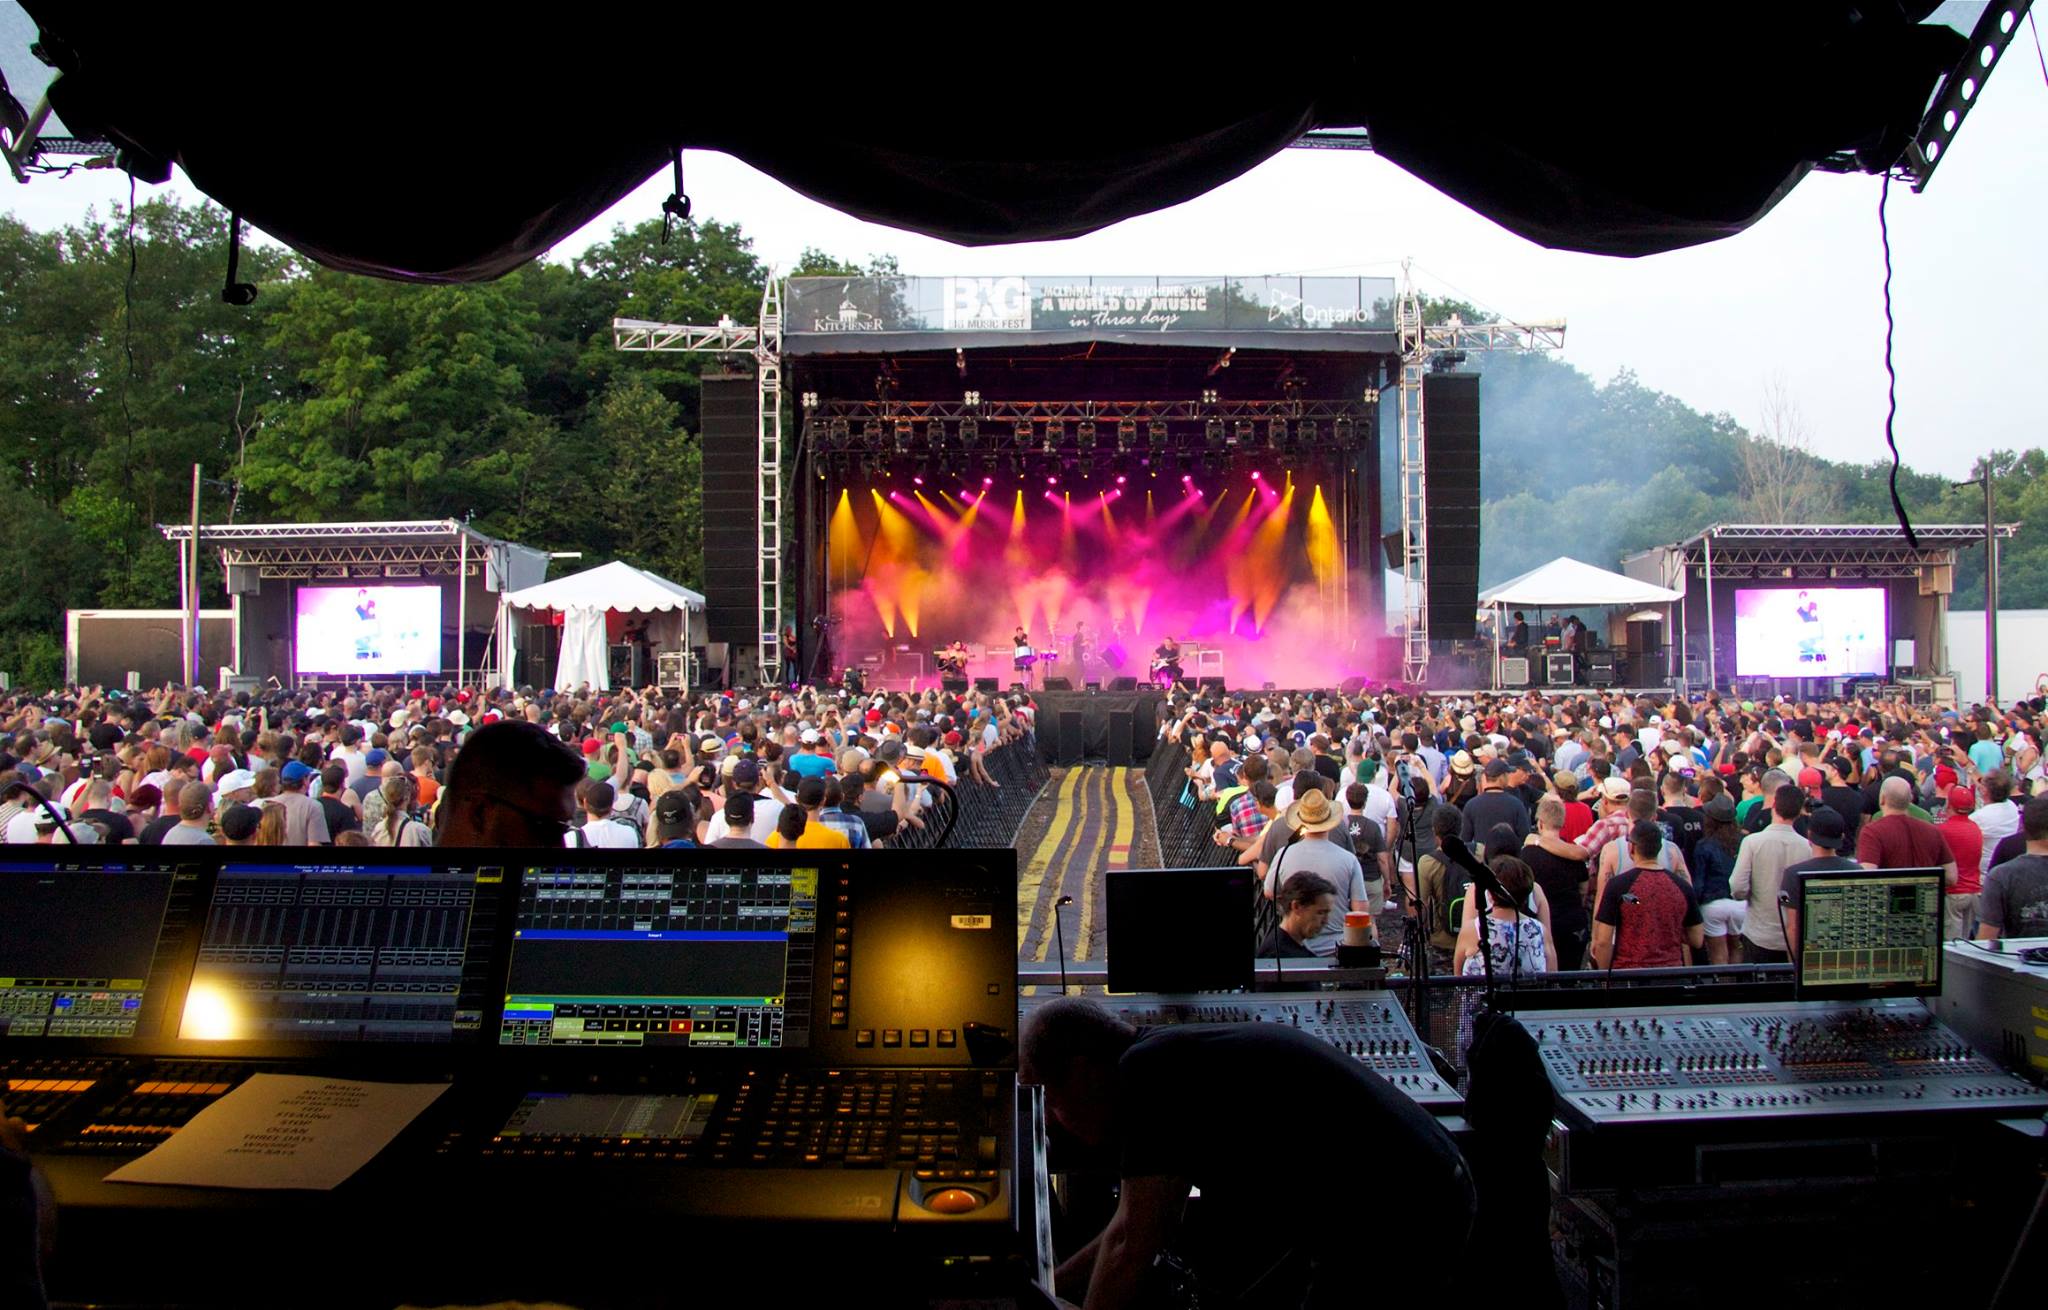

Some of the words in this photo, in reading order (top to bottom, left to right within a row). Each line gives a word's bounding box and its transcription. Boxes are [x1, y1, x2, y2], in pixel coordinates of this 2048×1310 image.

[1041, 297, 1054, 311] A
[1057, 297, 1121, 311] WORLD
[1124, 297, 1146, 311] OF
[1151, 297, 1207, 311] MUSIC
[1068, 313, 1089, 328] in
[1091, 308, 1137, 327] three
[1140, 308, 1181, 332] days
[1302, 304, 1368, 323] Ontario
[813, 317, 884, 332] KITCHENER
[967, 319, 999, 329] MUSIC
[1001, 319, 1026, 329] FEST
